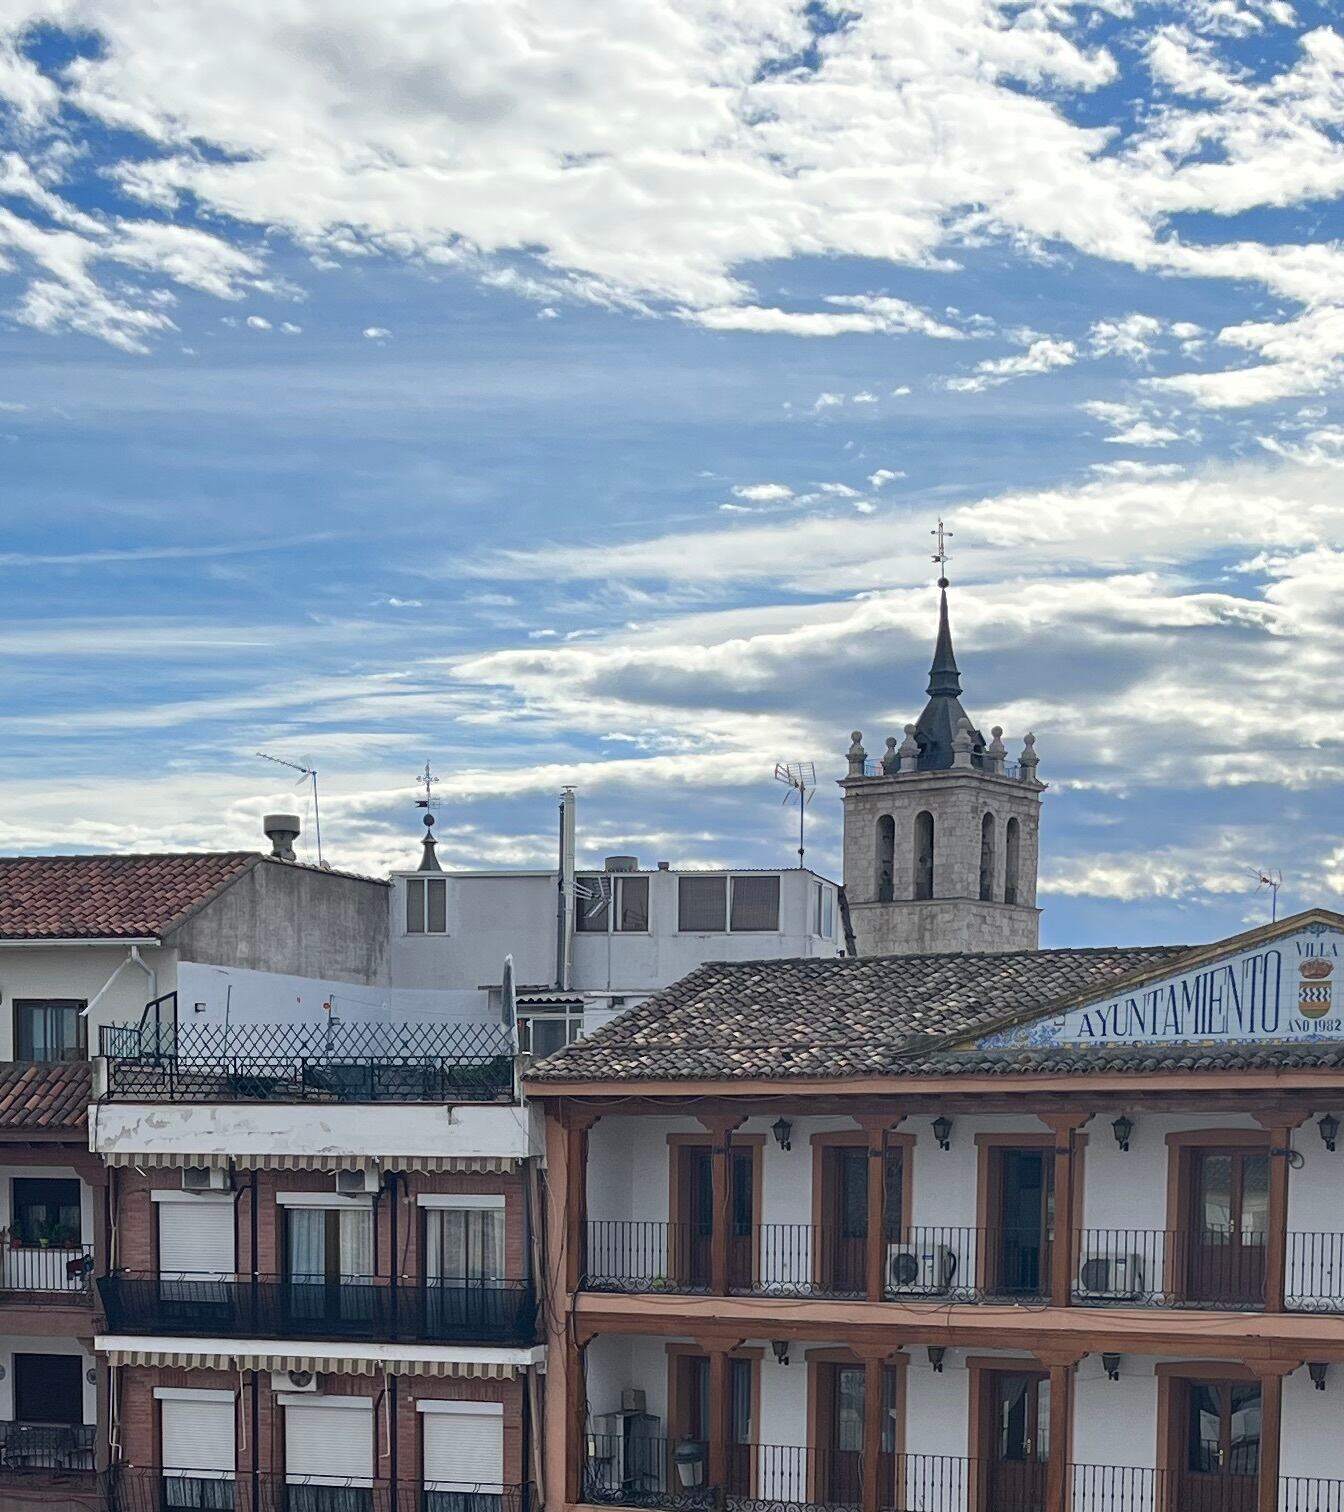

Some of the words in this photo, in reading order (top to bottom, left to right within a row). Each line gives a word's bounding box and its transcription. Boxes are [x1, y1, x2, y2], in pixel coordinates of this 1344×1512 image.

[1296, 942, 1338, 957] VILLA
[1077, 950, 1282, 1037] AYUNTAMIENTO
[1315, 1019, 1342, 1031] 1982
